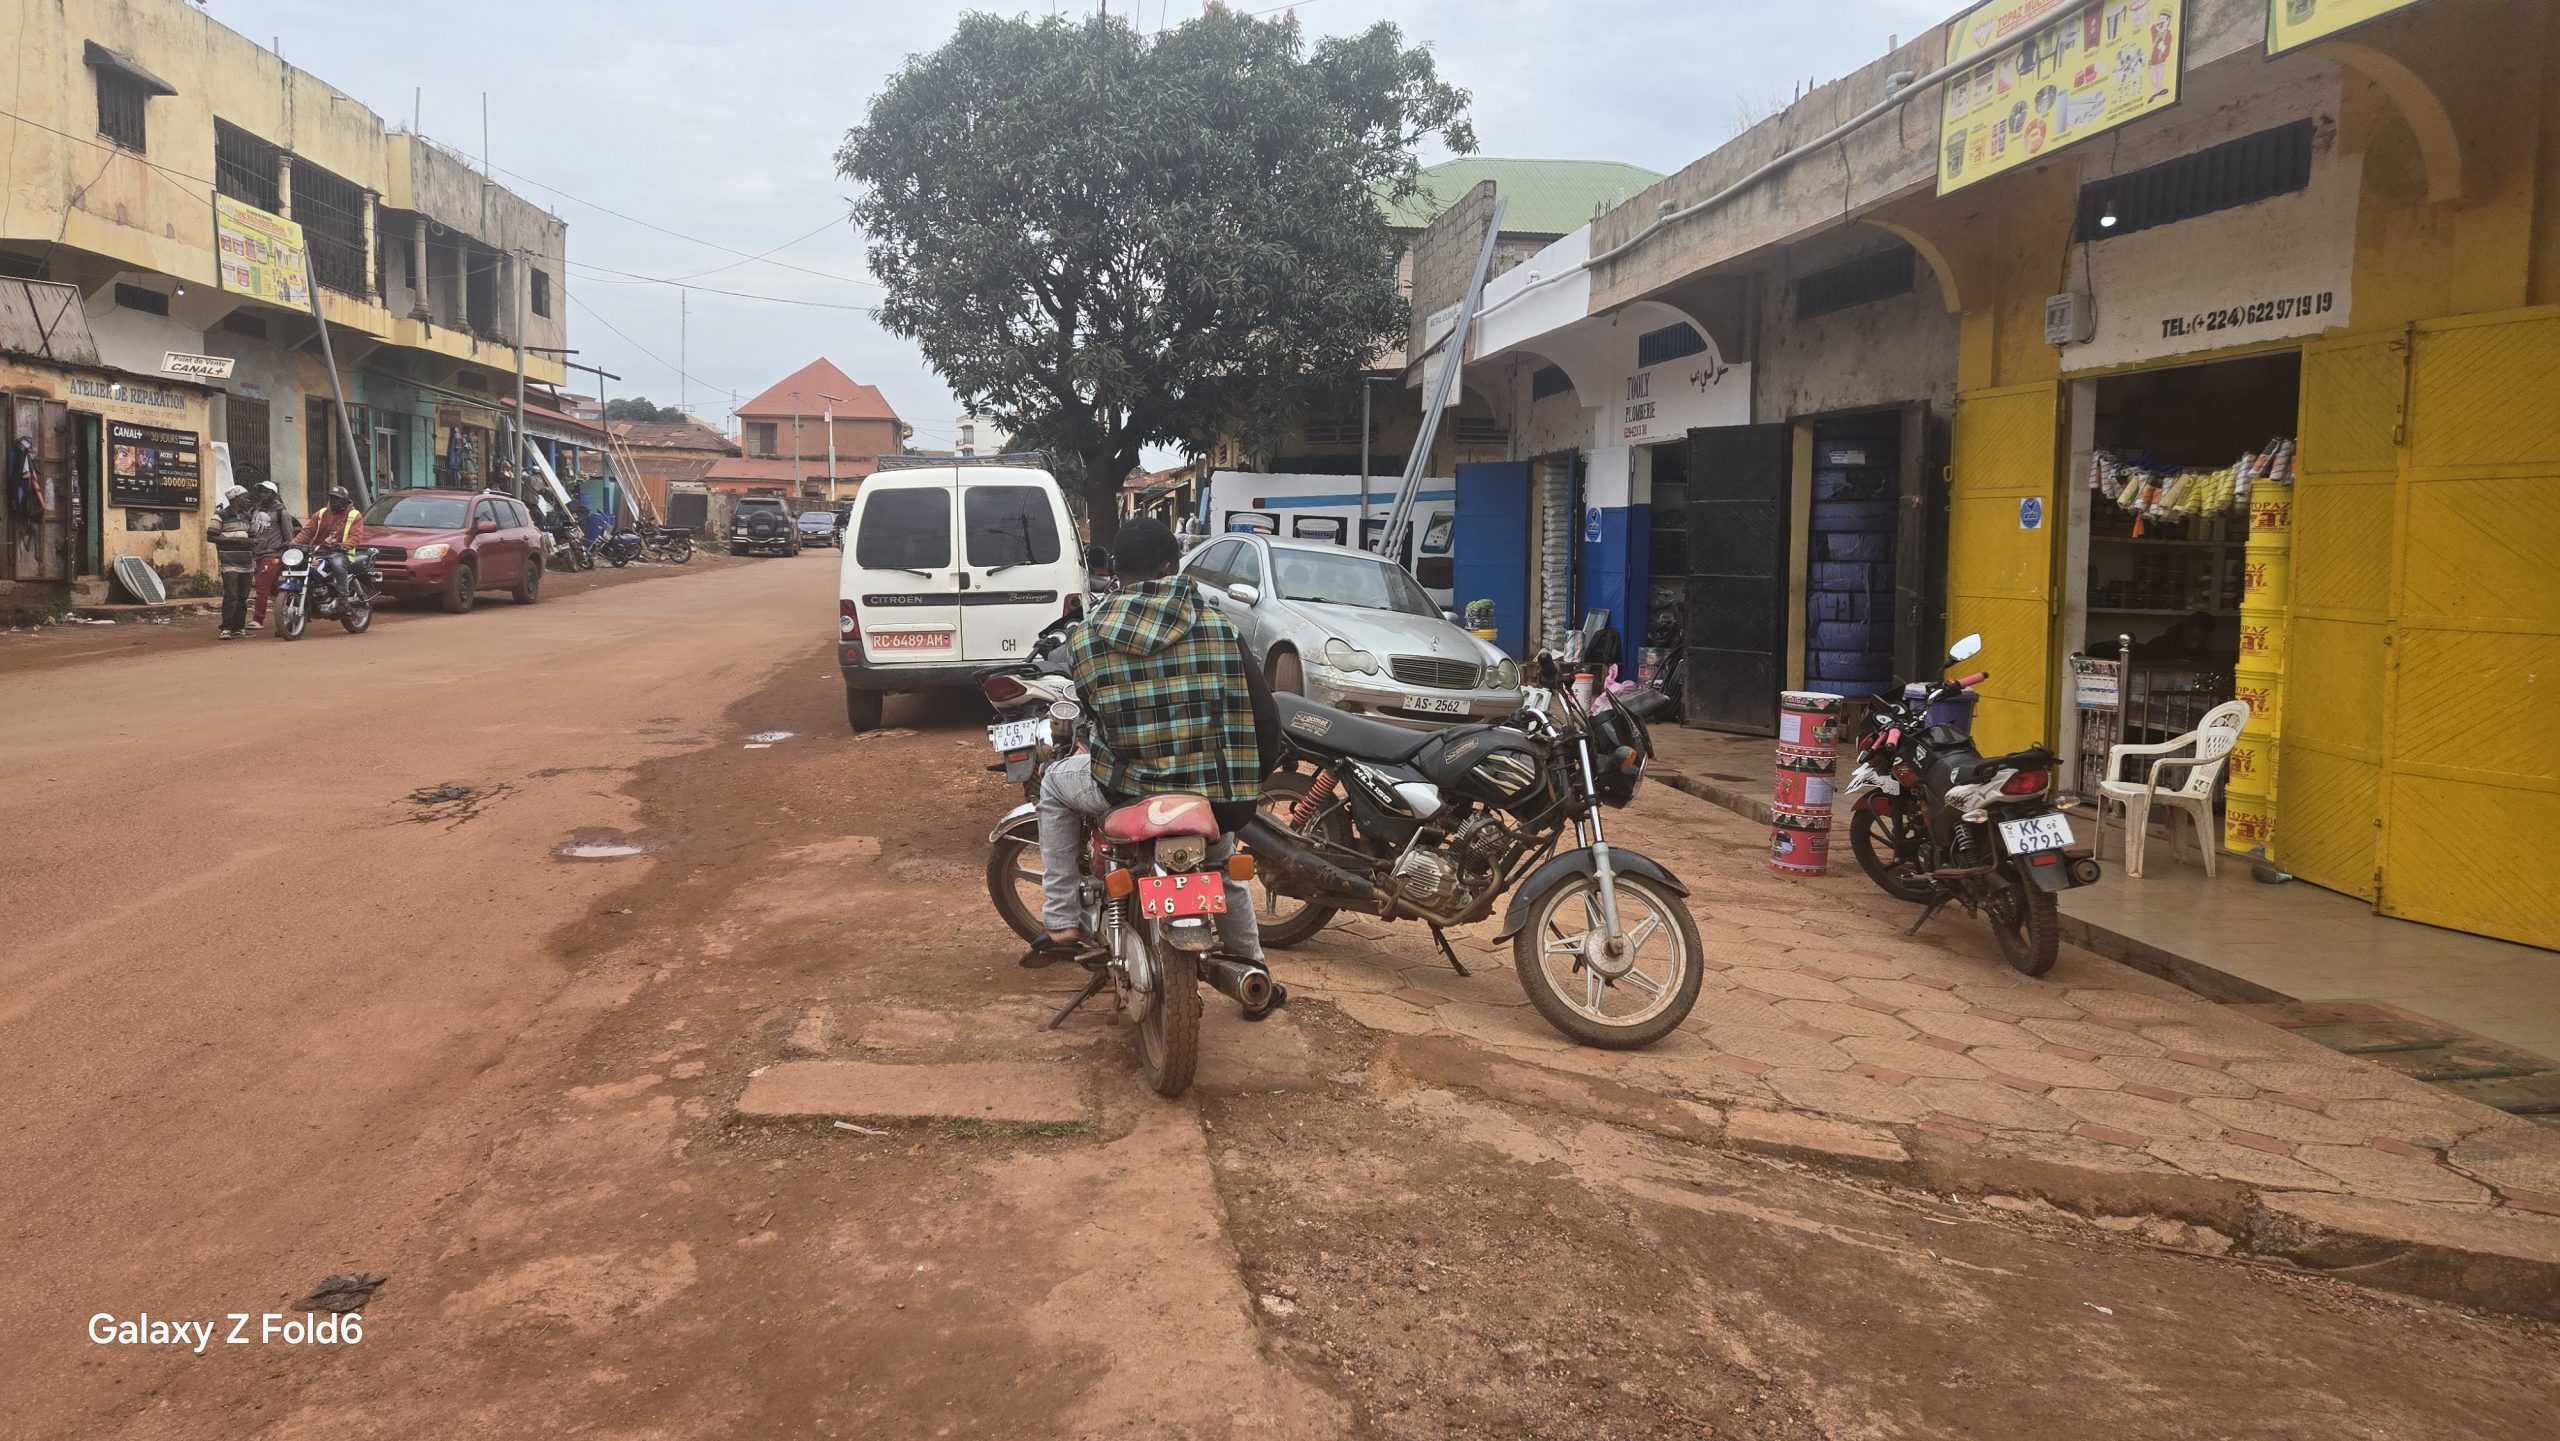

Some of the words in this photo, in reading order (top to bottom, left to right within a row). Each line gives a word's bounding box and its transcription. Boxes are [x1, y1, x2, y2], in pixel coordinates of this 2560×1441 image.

[1998, 5, 2023, 27] TOPAZ
[173, 355, 193, 363] Point
[205, 358, 227, 367] Vente
[171, 363, 224, 375] CANAL+
[70, 378, 113, 400] ATELIER
[1626, 371, 1651, 401] TOOLY
[1625, 401, 1656, 424] PLOMBERIE
[113, 426, 143, 439] CANAL+
[870, 594, 923, 604] CITROËN
[1007, 592, 1049, 602] Berlingo
[1002, 639, 1016, 651] CH
[1353, 768, 1376, 789] KLX
[2019, 820, 2043, 835] KK
[1174, 876, 1188, 889] P
